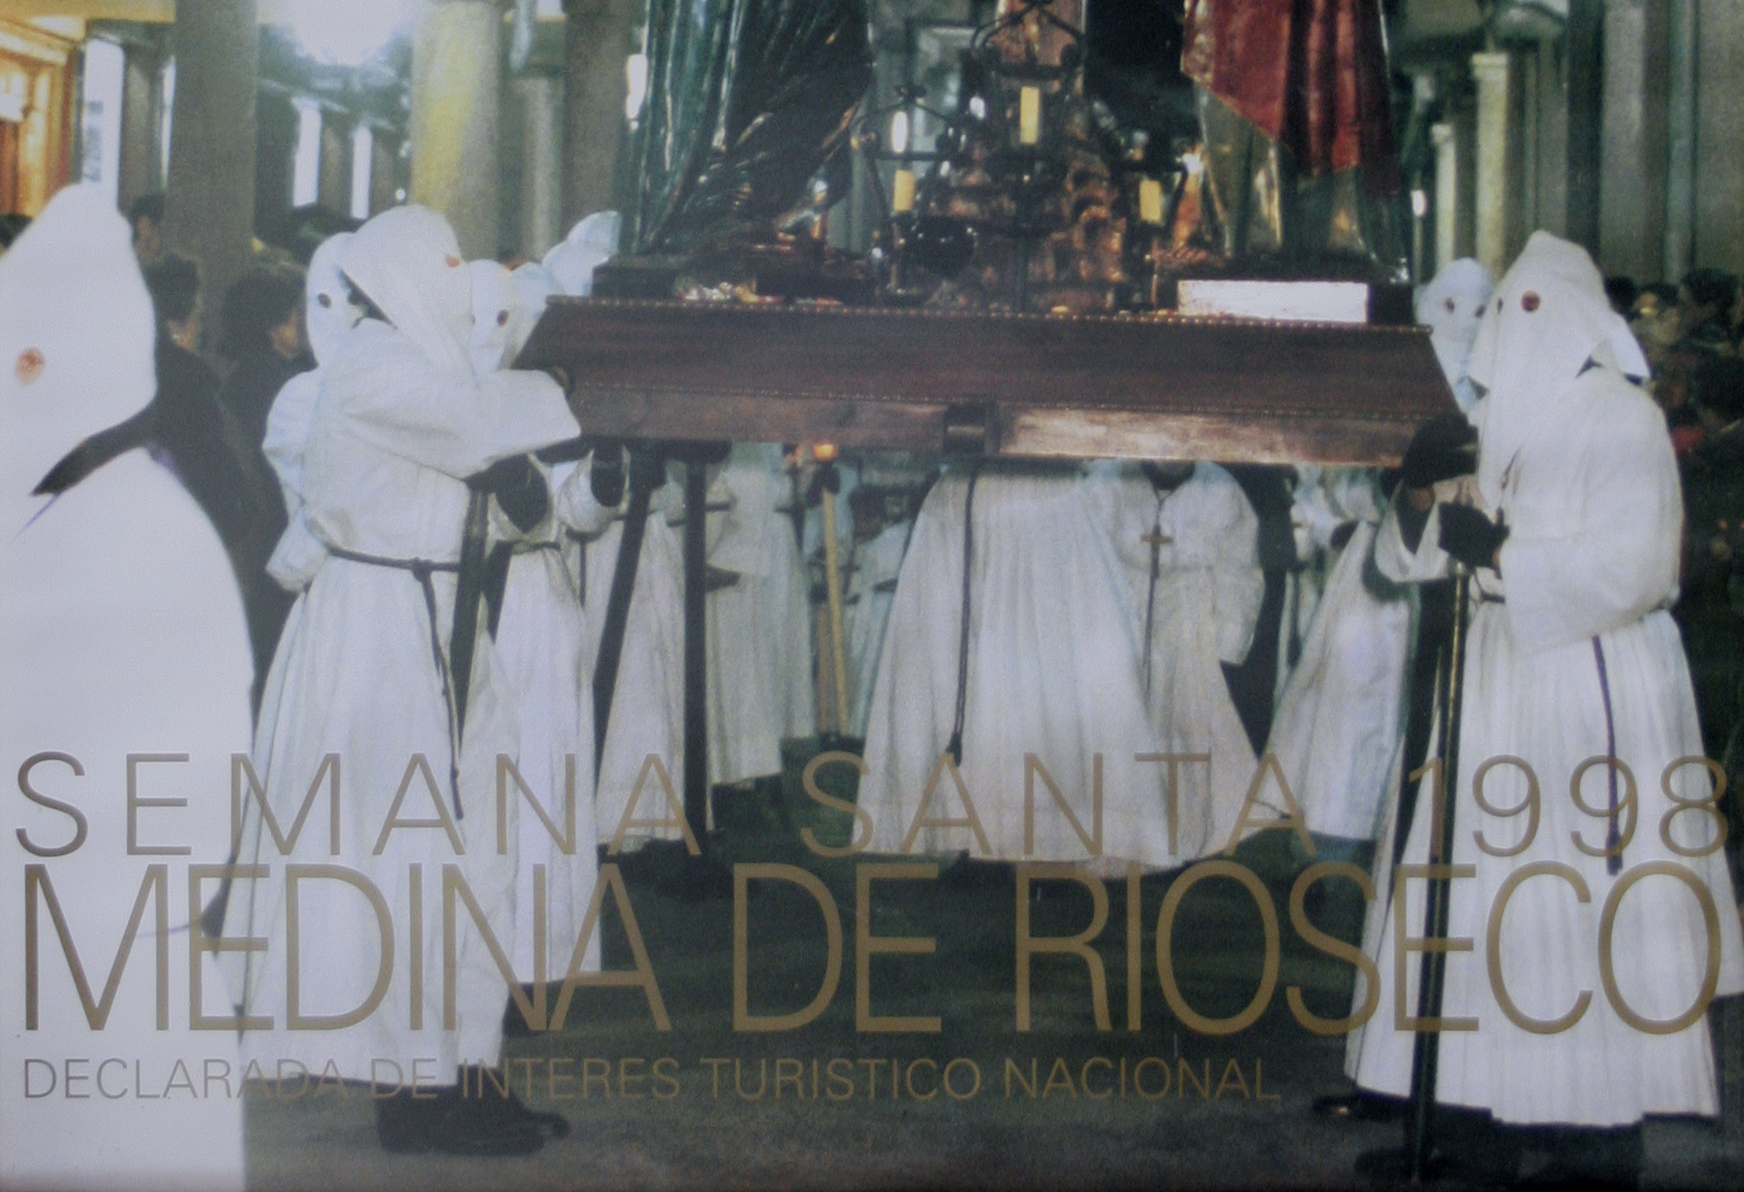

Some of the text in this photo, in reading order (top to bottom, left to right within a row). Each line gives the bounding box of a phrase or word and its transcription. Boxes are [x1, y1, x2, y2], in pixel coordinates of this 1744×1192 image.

[15, 751, 1730, 858] SEMANA SANTA 1998
[24, 860, 1722, 1036] MEDINA DE RIOSECO
[24, 1056, 1281, 1101] DECLARADA DE INTERES TURISTICO NACIONAL
